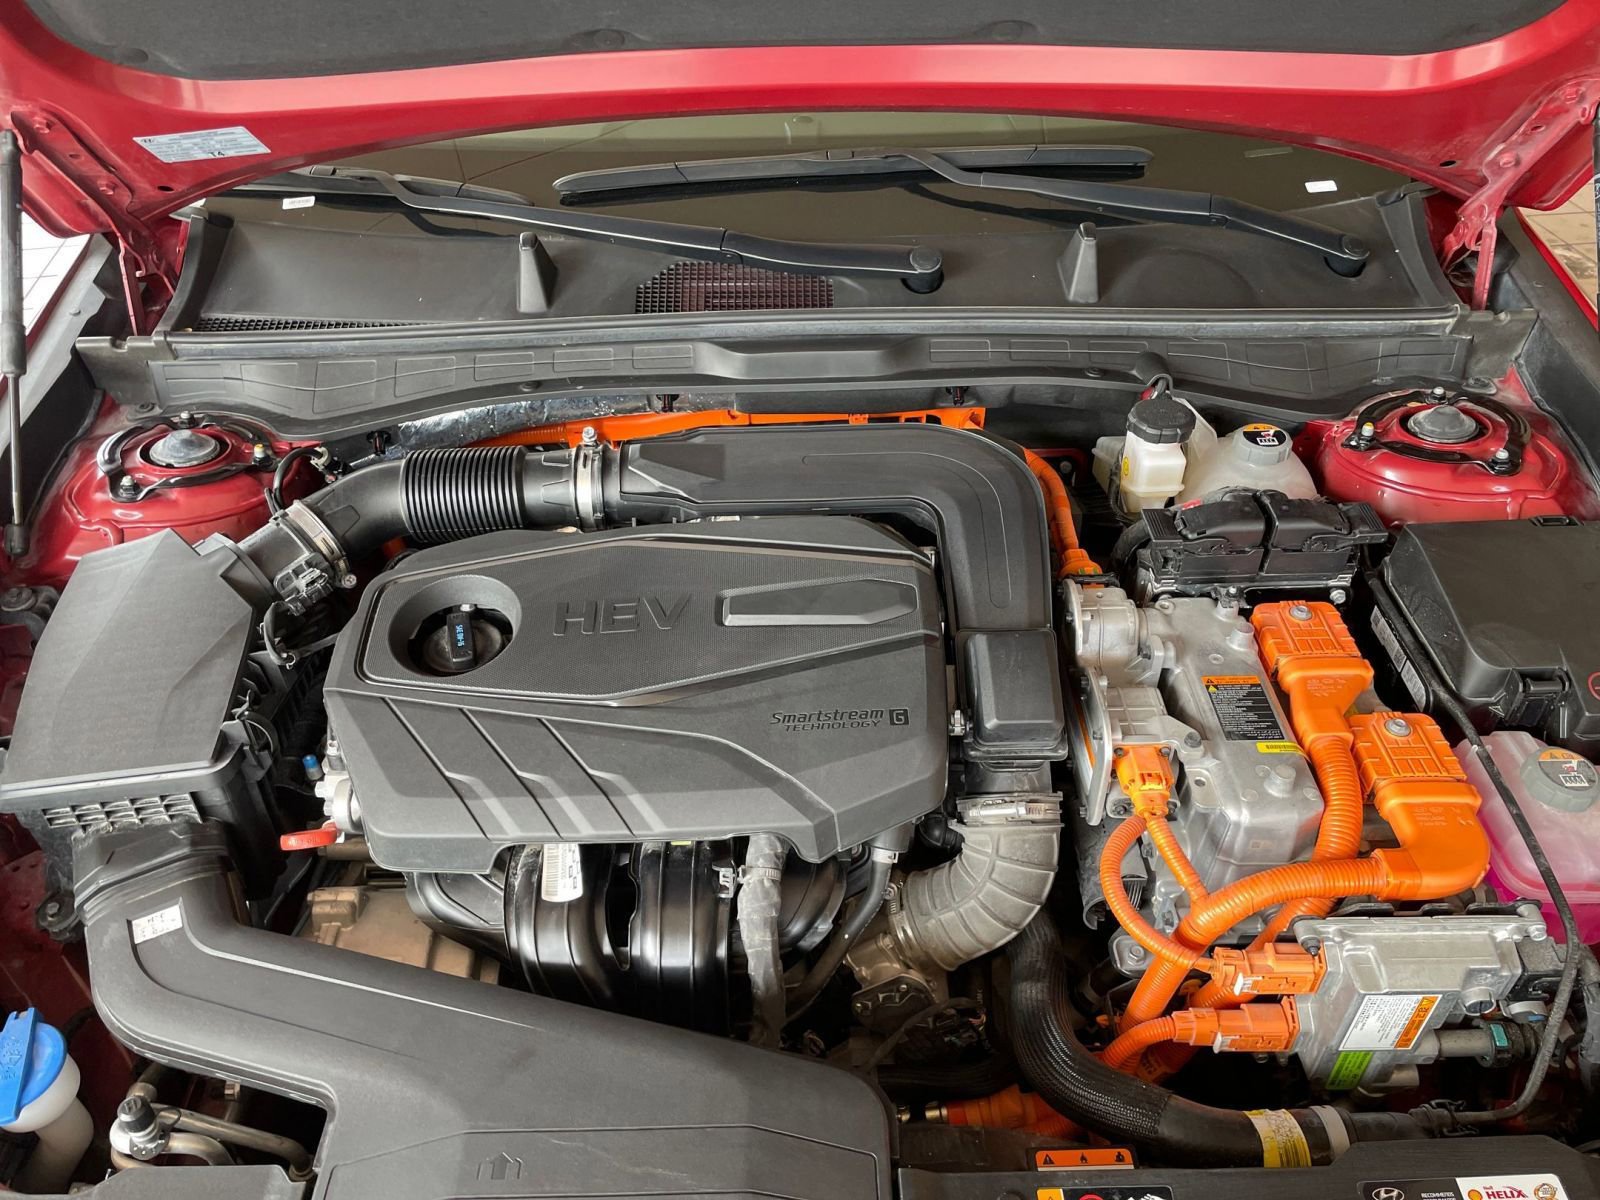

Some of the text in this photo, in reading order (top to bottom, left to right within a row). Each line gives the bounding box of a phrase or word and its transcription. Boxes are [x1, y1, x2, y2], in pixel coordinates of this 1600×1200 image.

[552, 594, 692, 636] HEV
[770, 708, 885, 725] Smartstream
[784, 719, 881, 732] TECHNOLOGY
[1485, 1189, 1526, 1200] HELIX
